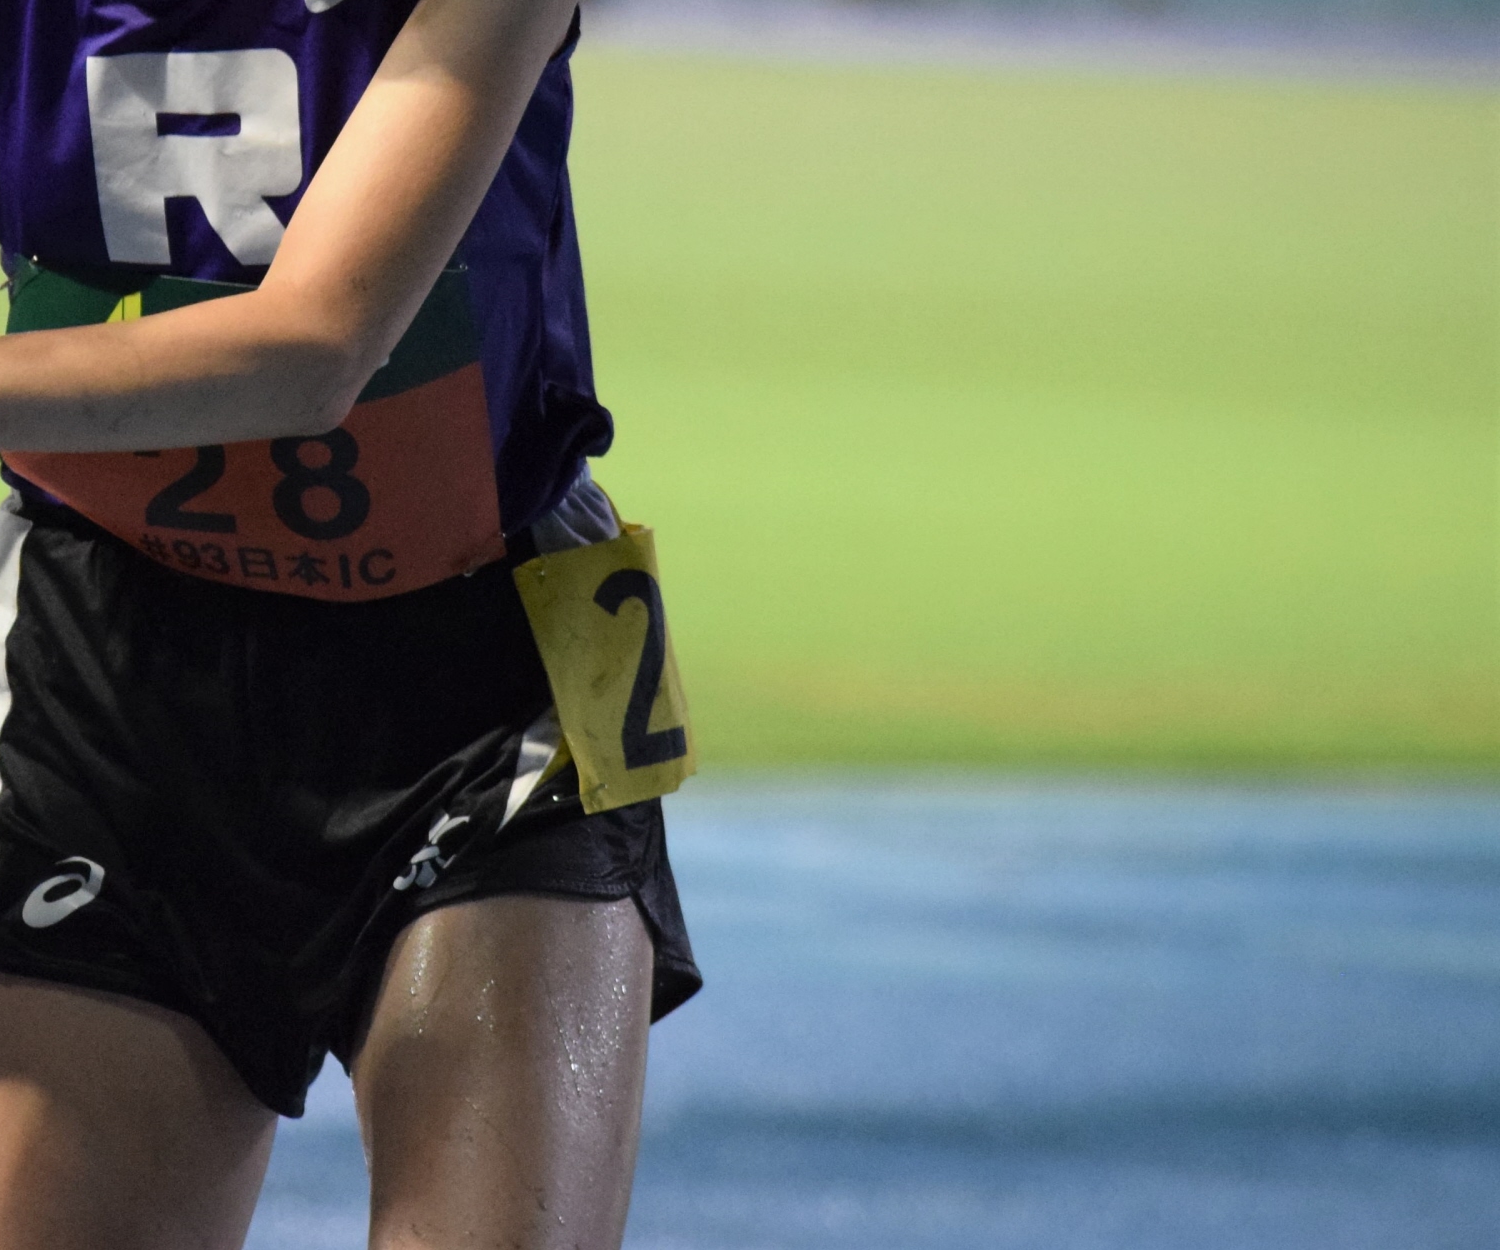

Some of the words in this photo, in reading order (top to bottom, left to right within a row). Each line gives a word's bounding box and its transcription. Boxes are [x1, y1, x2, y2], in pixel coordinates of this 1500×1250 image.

[86, 48, 303, 266] R
[144, 428, 371, 539] 28
[594, 569, 688, 770] 2
